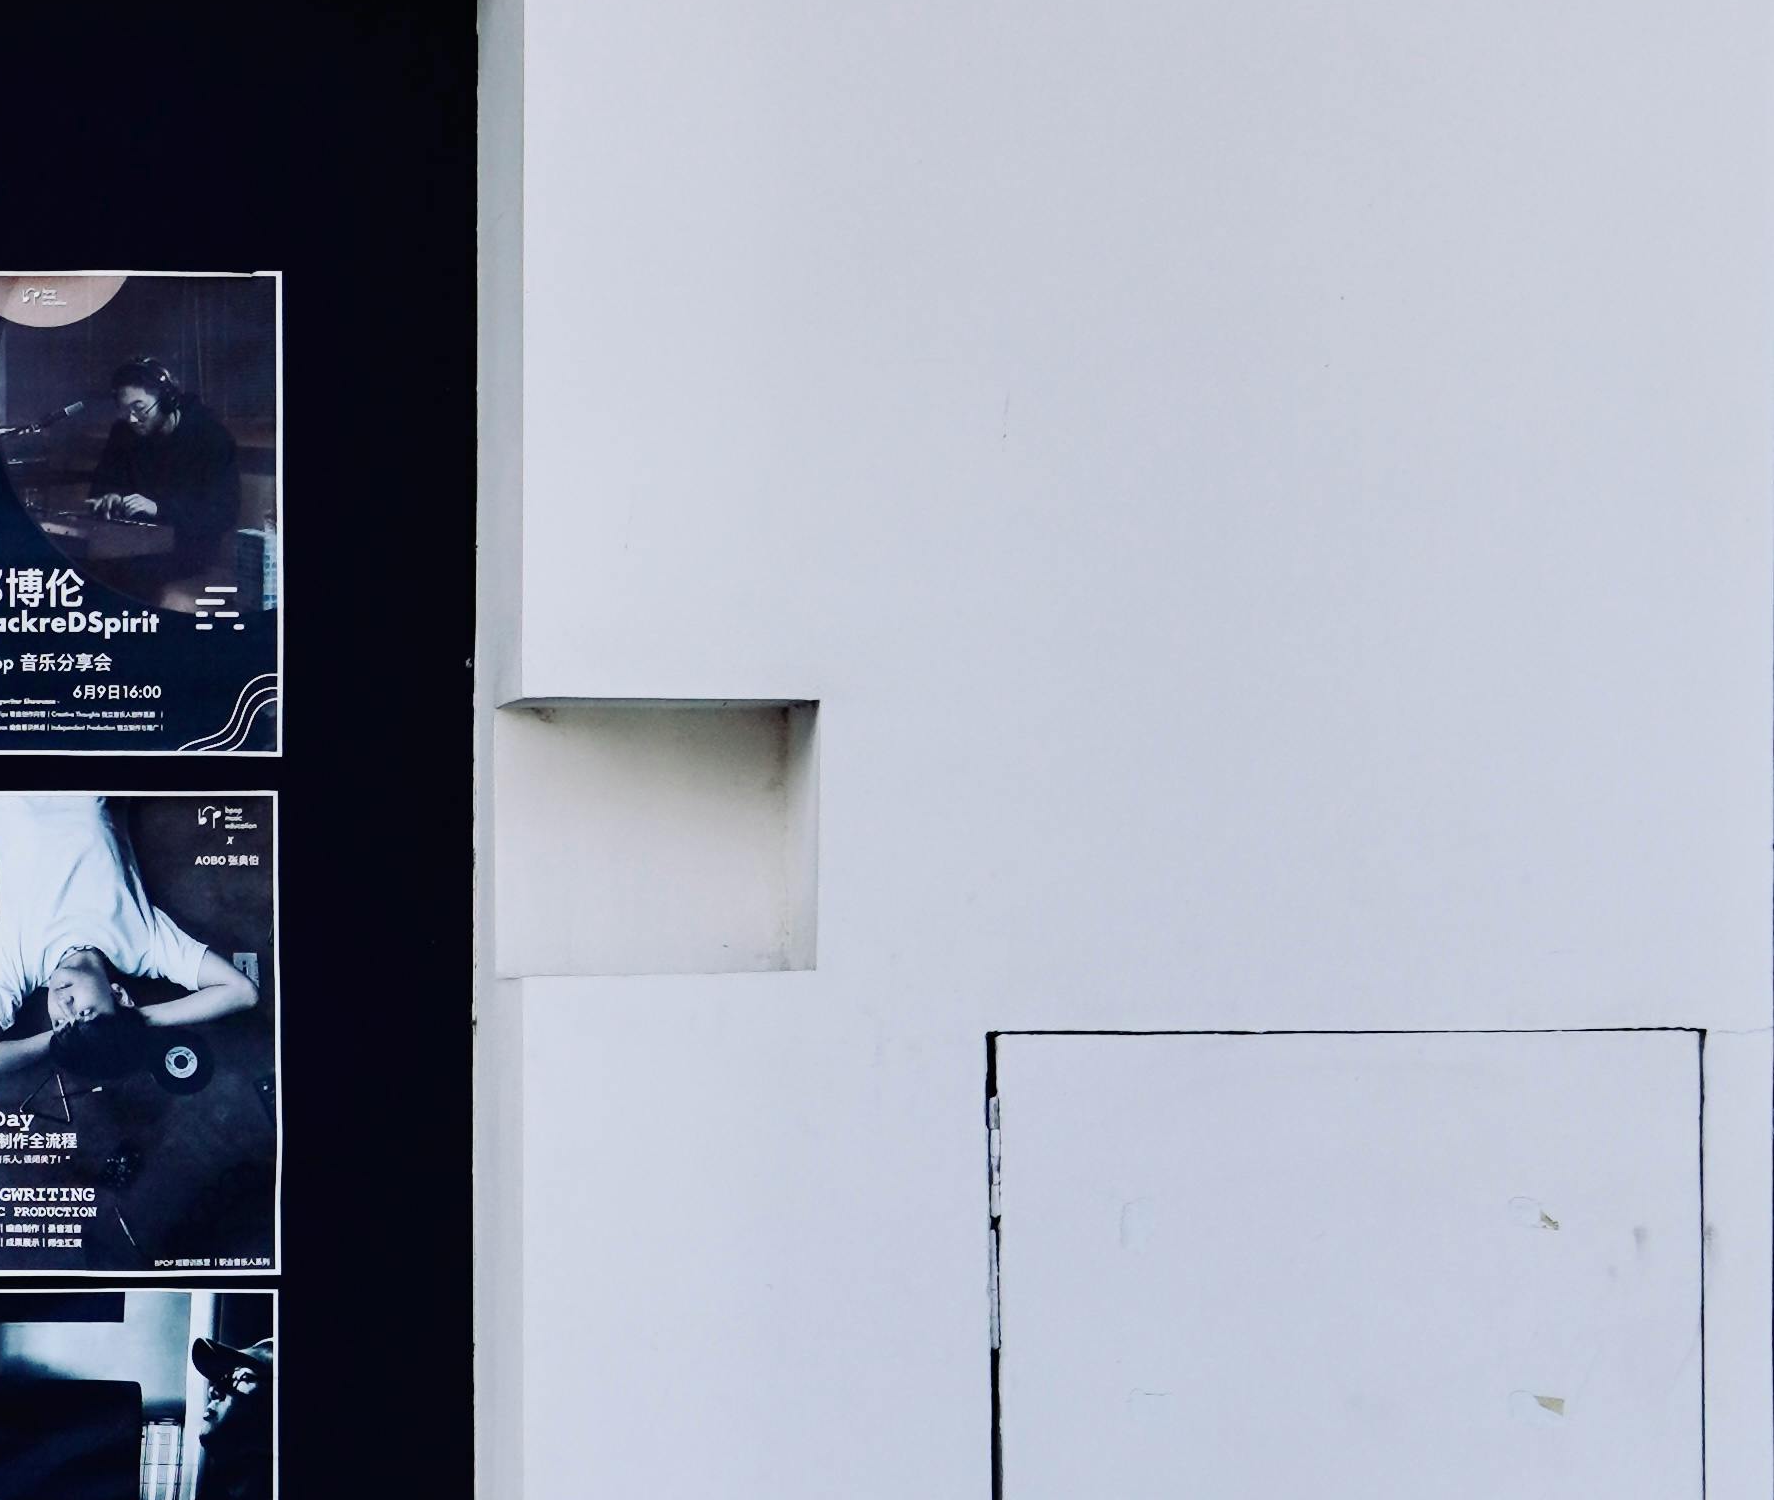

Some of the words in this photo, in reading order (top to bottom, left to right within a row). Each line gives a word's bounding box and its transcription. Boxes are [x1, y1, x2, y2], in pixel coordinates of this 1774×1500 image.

[20, 653, 112, 671] 音乐分享会
[73, 685, 161, 699] 6月9日16:00
[195, 855, 226, 866] AOBO
[13, 1206, 98, 1217] PRODUCTION
